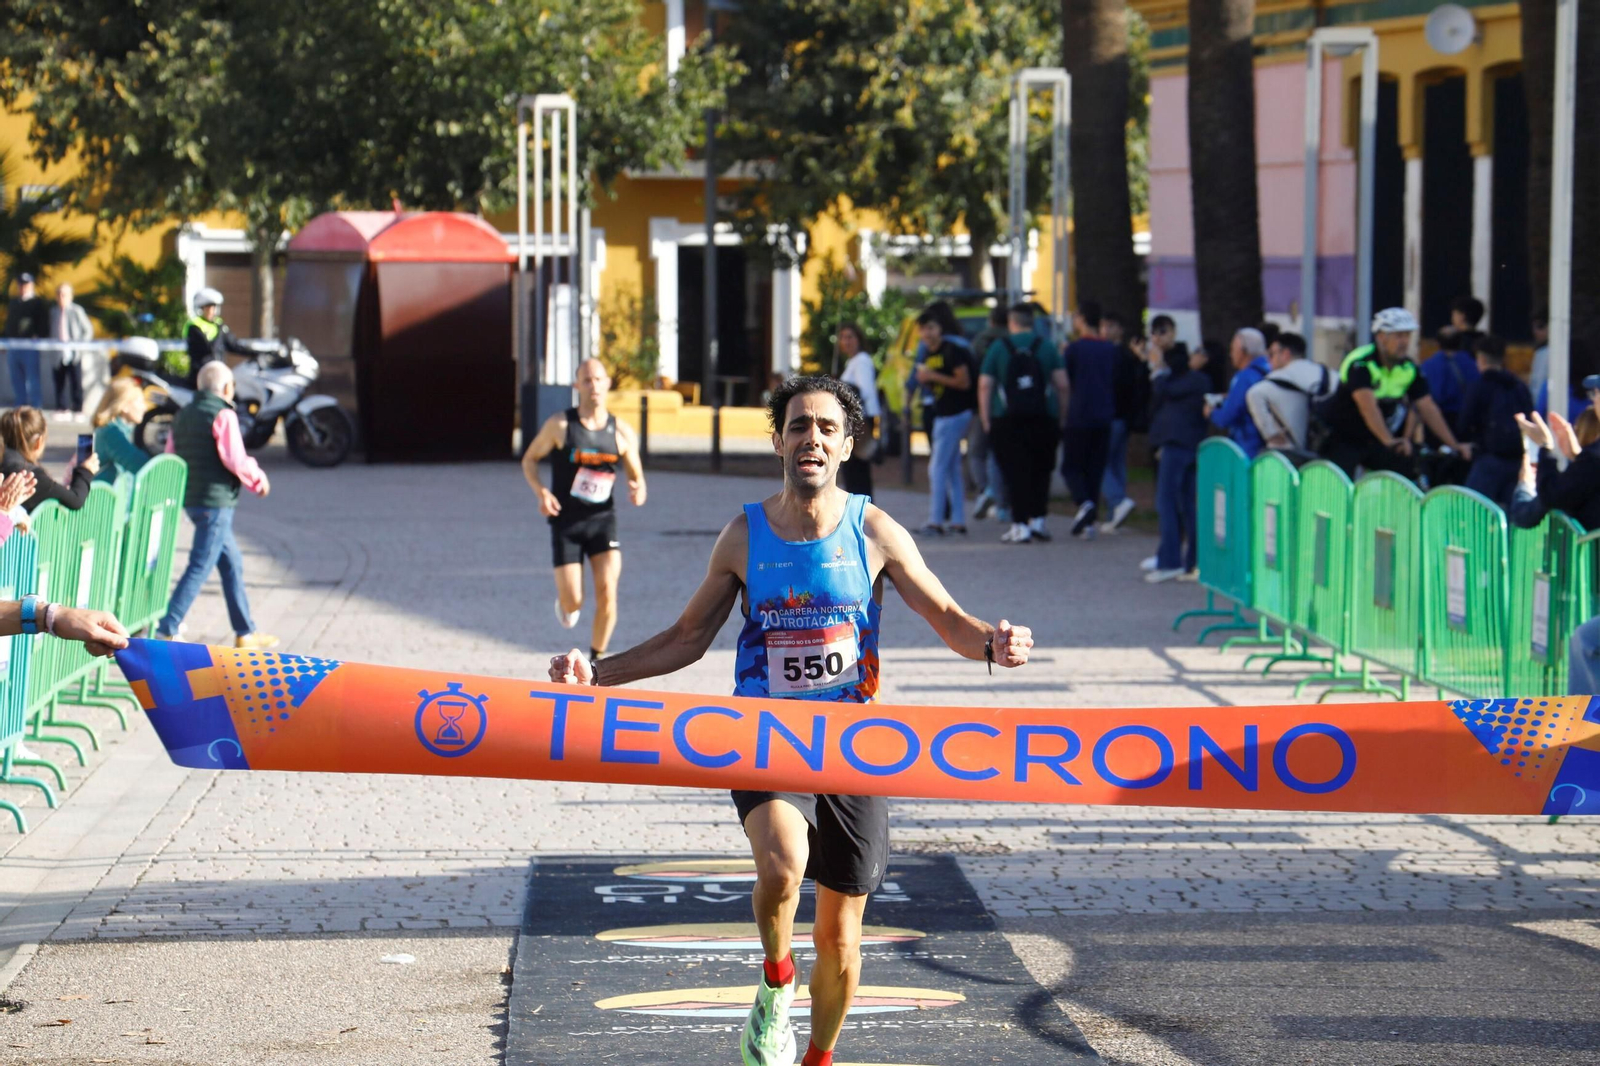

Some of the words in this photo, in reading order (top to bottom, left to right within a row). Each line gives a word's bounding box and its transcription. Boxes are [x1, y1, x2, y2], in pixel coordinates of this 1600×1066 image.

[760, 609, 780, 630] 20
[779, 607, 818, 617] CARRERA
[820, 604, 863, 614] NOCTURNA
[783, 651, 843, 682] 550
[530, 690, 1357, 794] TECNOCRONO
